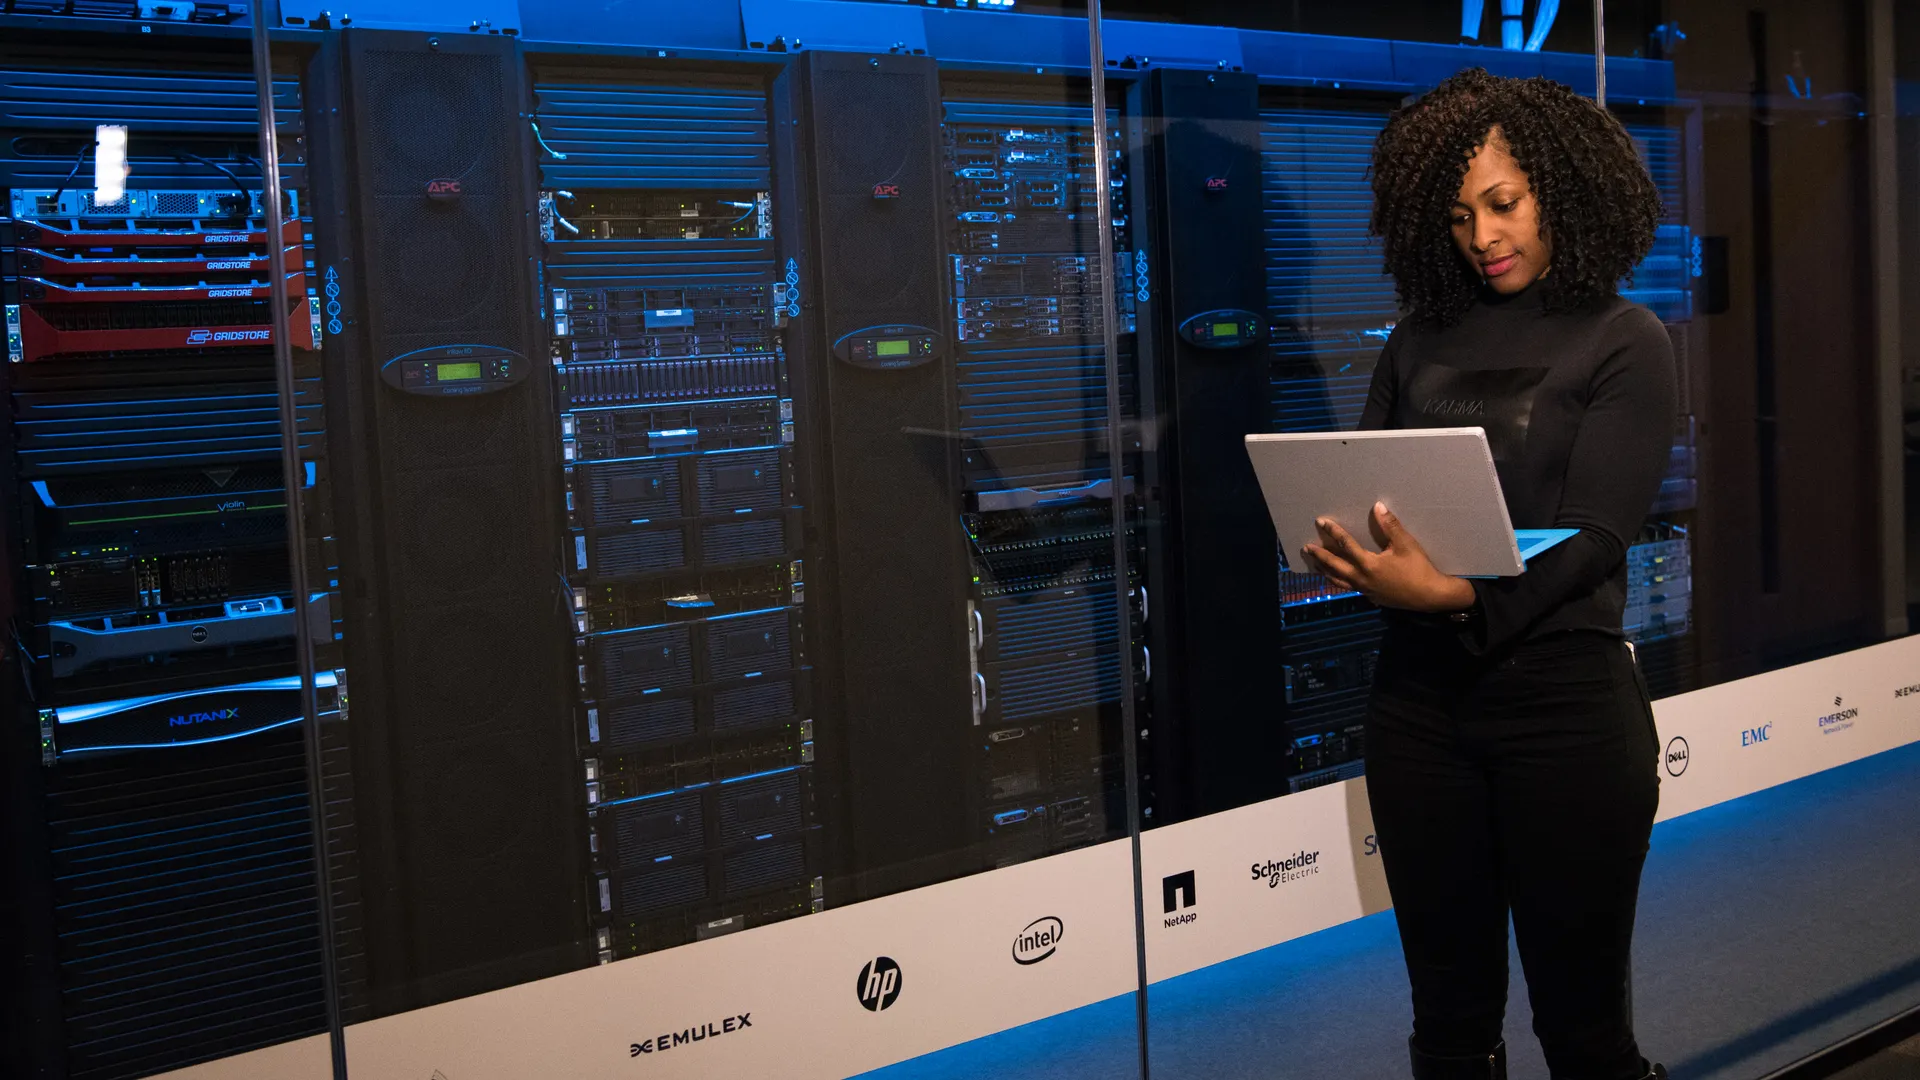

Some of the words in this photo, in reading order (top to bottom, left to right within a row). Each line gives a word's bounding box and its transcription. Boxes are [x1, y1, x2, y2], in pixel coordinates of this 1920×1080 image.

[427, 181, 461, 193] APC
[874, 185, 900, 195] APC
[1207, 178, 1229, 188] APC
[204, 234, 250, 243] GRIDSTORE
[206, 260, 252, 270] GRIDSTORE
[208, 288, 253, 298] GRIDSTORE
[213, 330, 270, 341] GRIDSTORE
[217, 499, 245, 512] Violin
[169, 707, 239, 727] NUTANIX
[1818, 707, 1858, 727] EMERSON
[1668, 749, 1687, 764] DELL
[1251, 850, 1320, 881] Schneider
[1281, 865, 1319, 884] Electric
[1164, 912, 1197, 929] NetApp
[1019, 924, 1056, 953] intel
[861, 958, 899, 1011] hp
[657, 1012, 753, 1052] EMULEX
